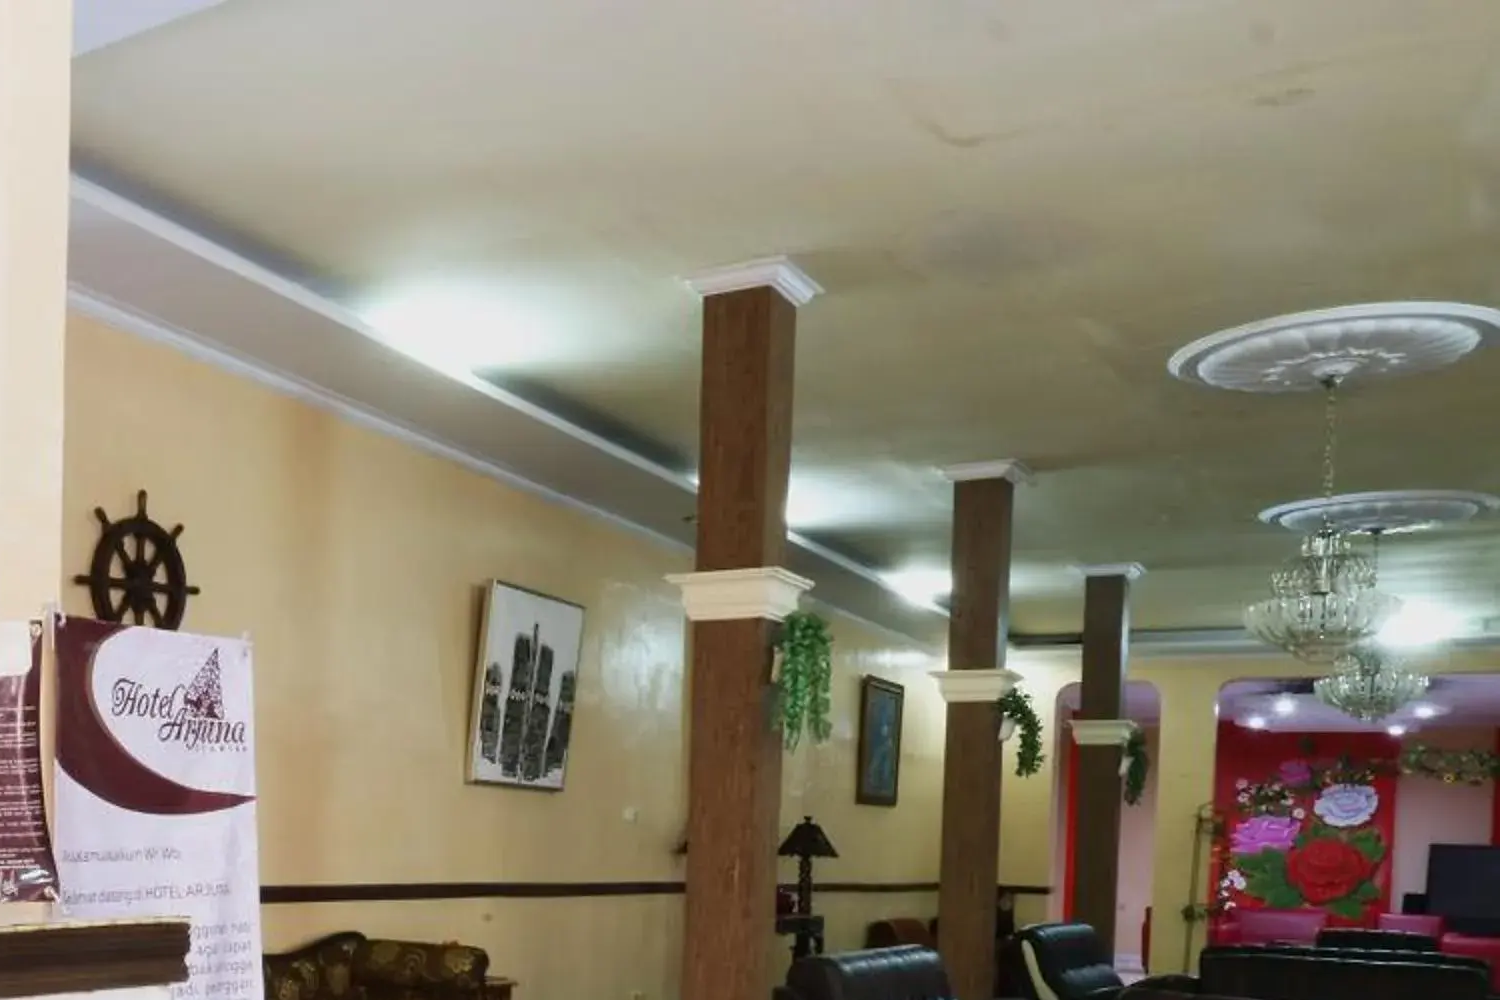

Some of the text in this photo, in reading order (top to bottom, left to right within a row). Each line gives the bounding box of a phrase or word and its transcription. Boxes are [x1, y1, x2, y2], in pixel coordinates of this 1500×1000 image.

[111, 677, 245, 750] Hotel Arjuna
[145, 886, 184, 901] HOTEL
